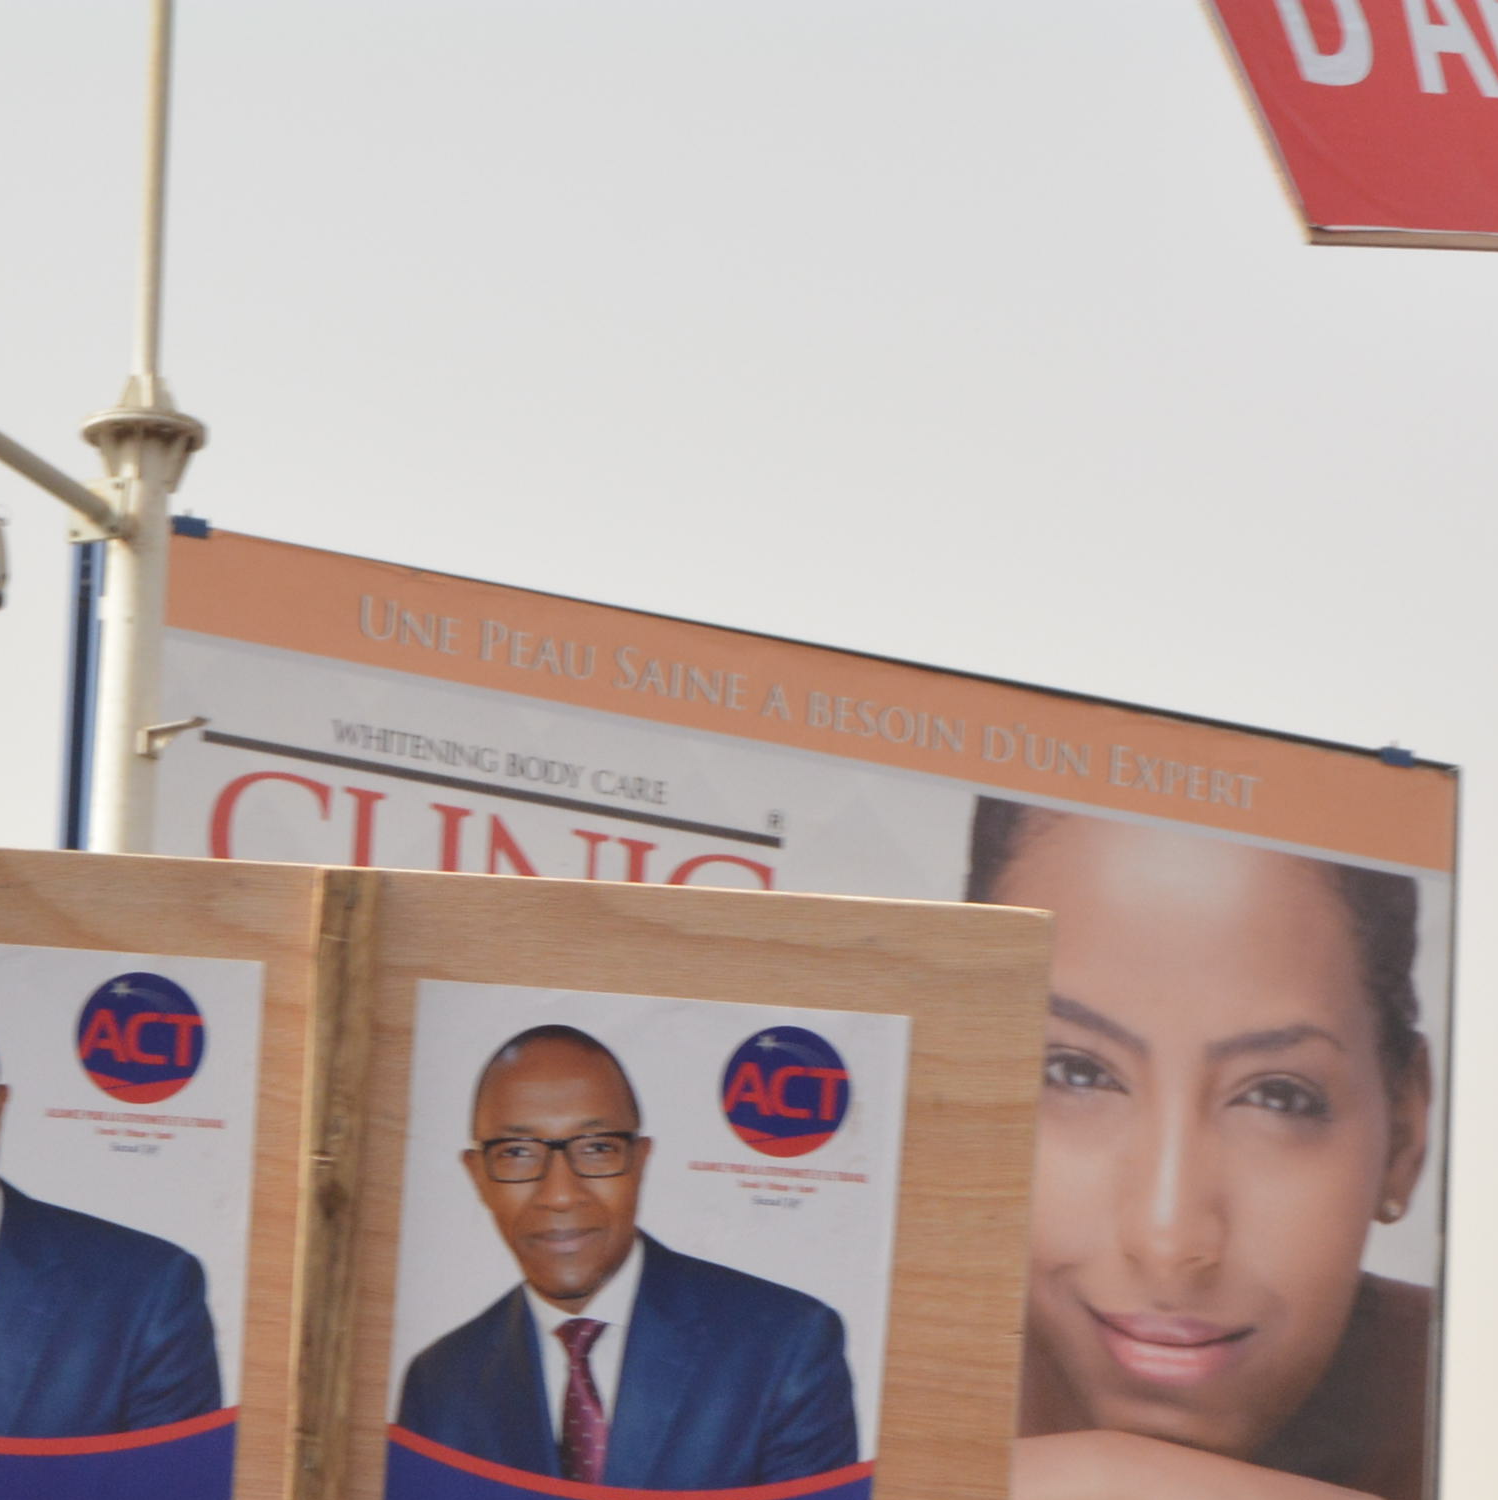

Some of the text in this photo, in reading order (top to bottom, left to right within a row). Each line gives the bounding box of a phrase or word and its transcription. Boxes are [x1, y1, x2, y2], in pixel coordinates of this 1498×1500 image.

[358, 594, 463, 655] UNE
[479, 618, 597, 681] PEAU
[613, 645, 749, 712] SAINE
[761, 682, 793, 722] A
[806, 690, 967, 754] BESOIN
[1108, 742, 1263, 811] EXPERT
[331, 718, 671, 806] WHITENING BODY CARE
[78, 1008, 206, 1067] ACT
[721, 1061, 851, 1122] ACT
